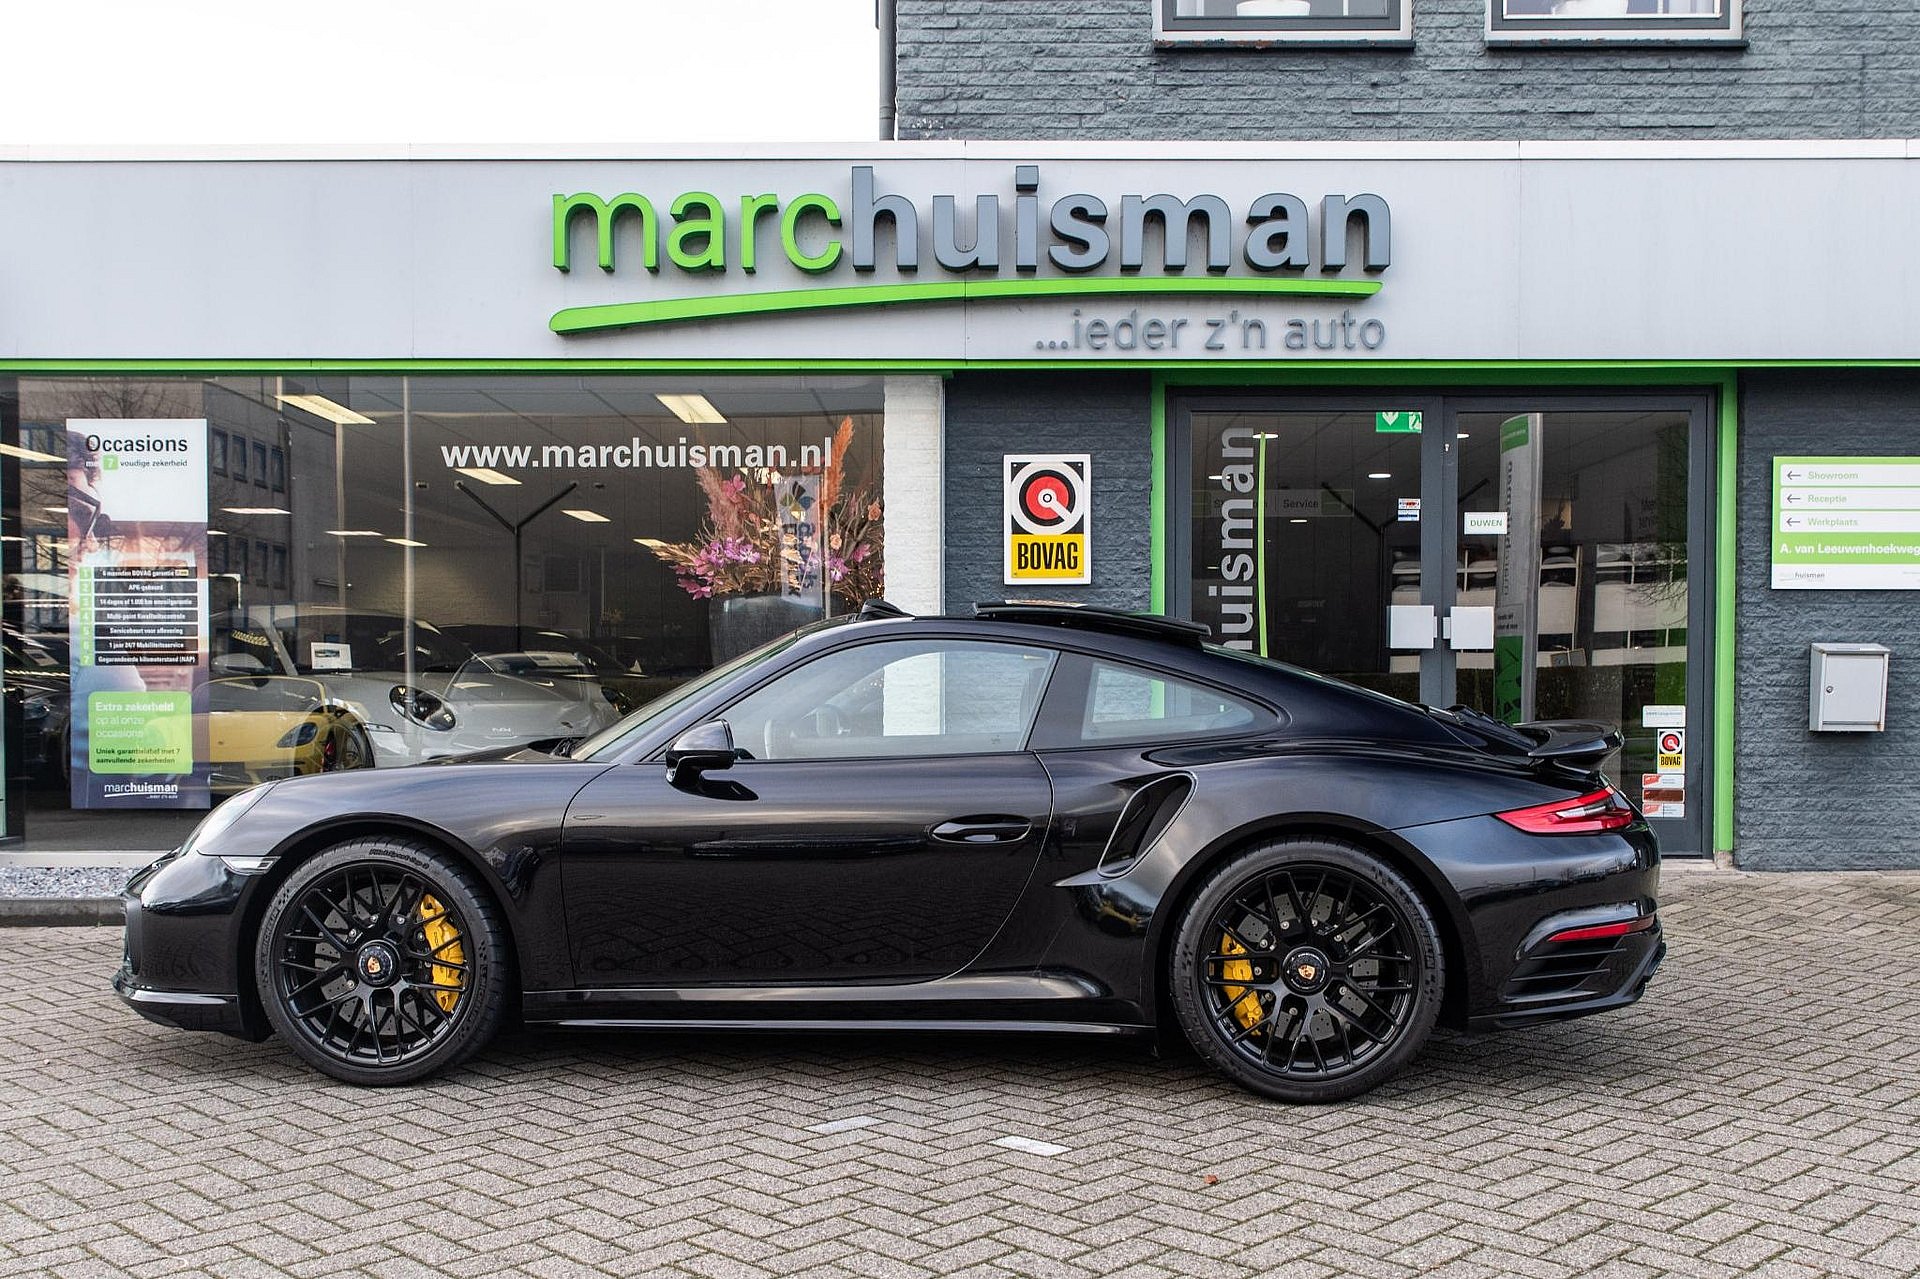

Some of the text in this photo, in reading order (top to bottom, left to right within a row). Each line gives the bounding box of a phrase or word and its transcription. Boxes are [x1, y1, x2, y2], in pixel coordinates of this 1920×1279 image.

[552, 165, 1392, 274] marchuisman
[1036, 309, 1386, 351] ...ieder z'n auto
[86, 434, 188, 452] Occasions
[441, 436, 832, 469] www.marchuisman.nl
[120, 459, 150, 468] voudige
[152, 459, 188, 467] zekerheid
[1807, 471, 1859, 480] Showroom
[1283, 499, 1319, 509] Service
[1807, 495, 1848, 504] Receptie
[1470, 519, 1503, 528] DUWEN
[1807, 518, 1859, 527] Werkplaats
[1779, 543, 1920, 556] A. van Leeuwenhoekweg
[1017, 542, 1078, 570] BOVAG
[96, 701, 174, 712] Extra zekerheid
[95, 747, 115, 755] Uniek
[1660, 756, 1681, 766] BOVAG
[104, 782, 178, 792] marchuisman
